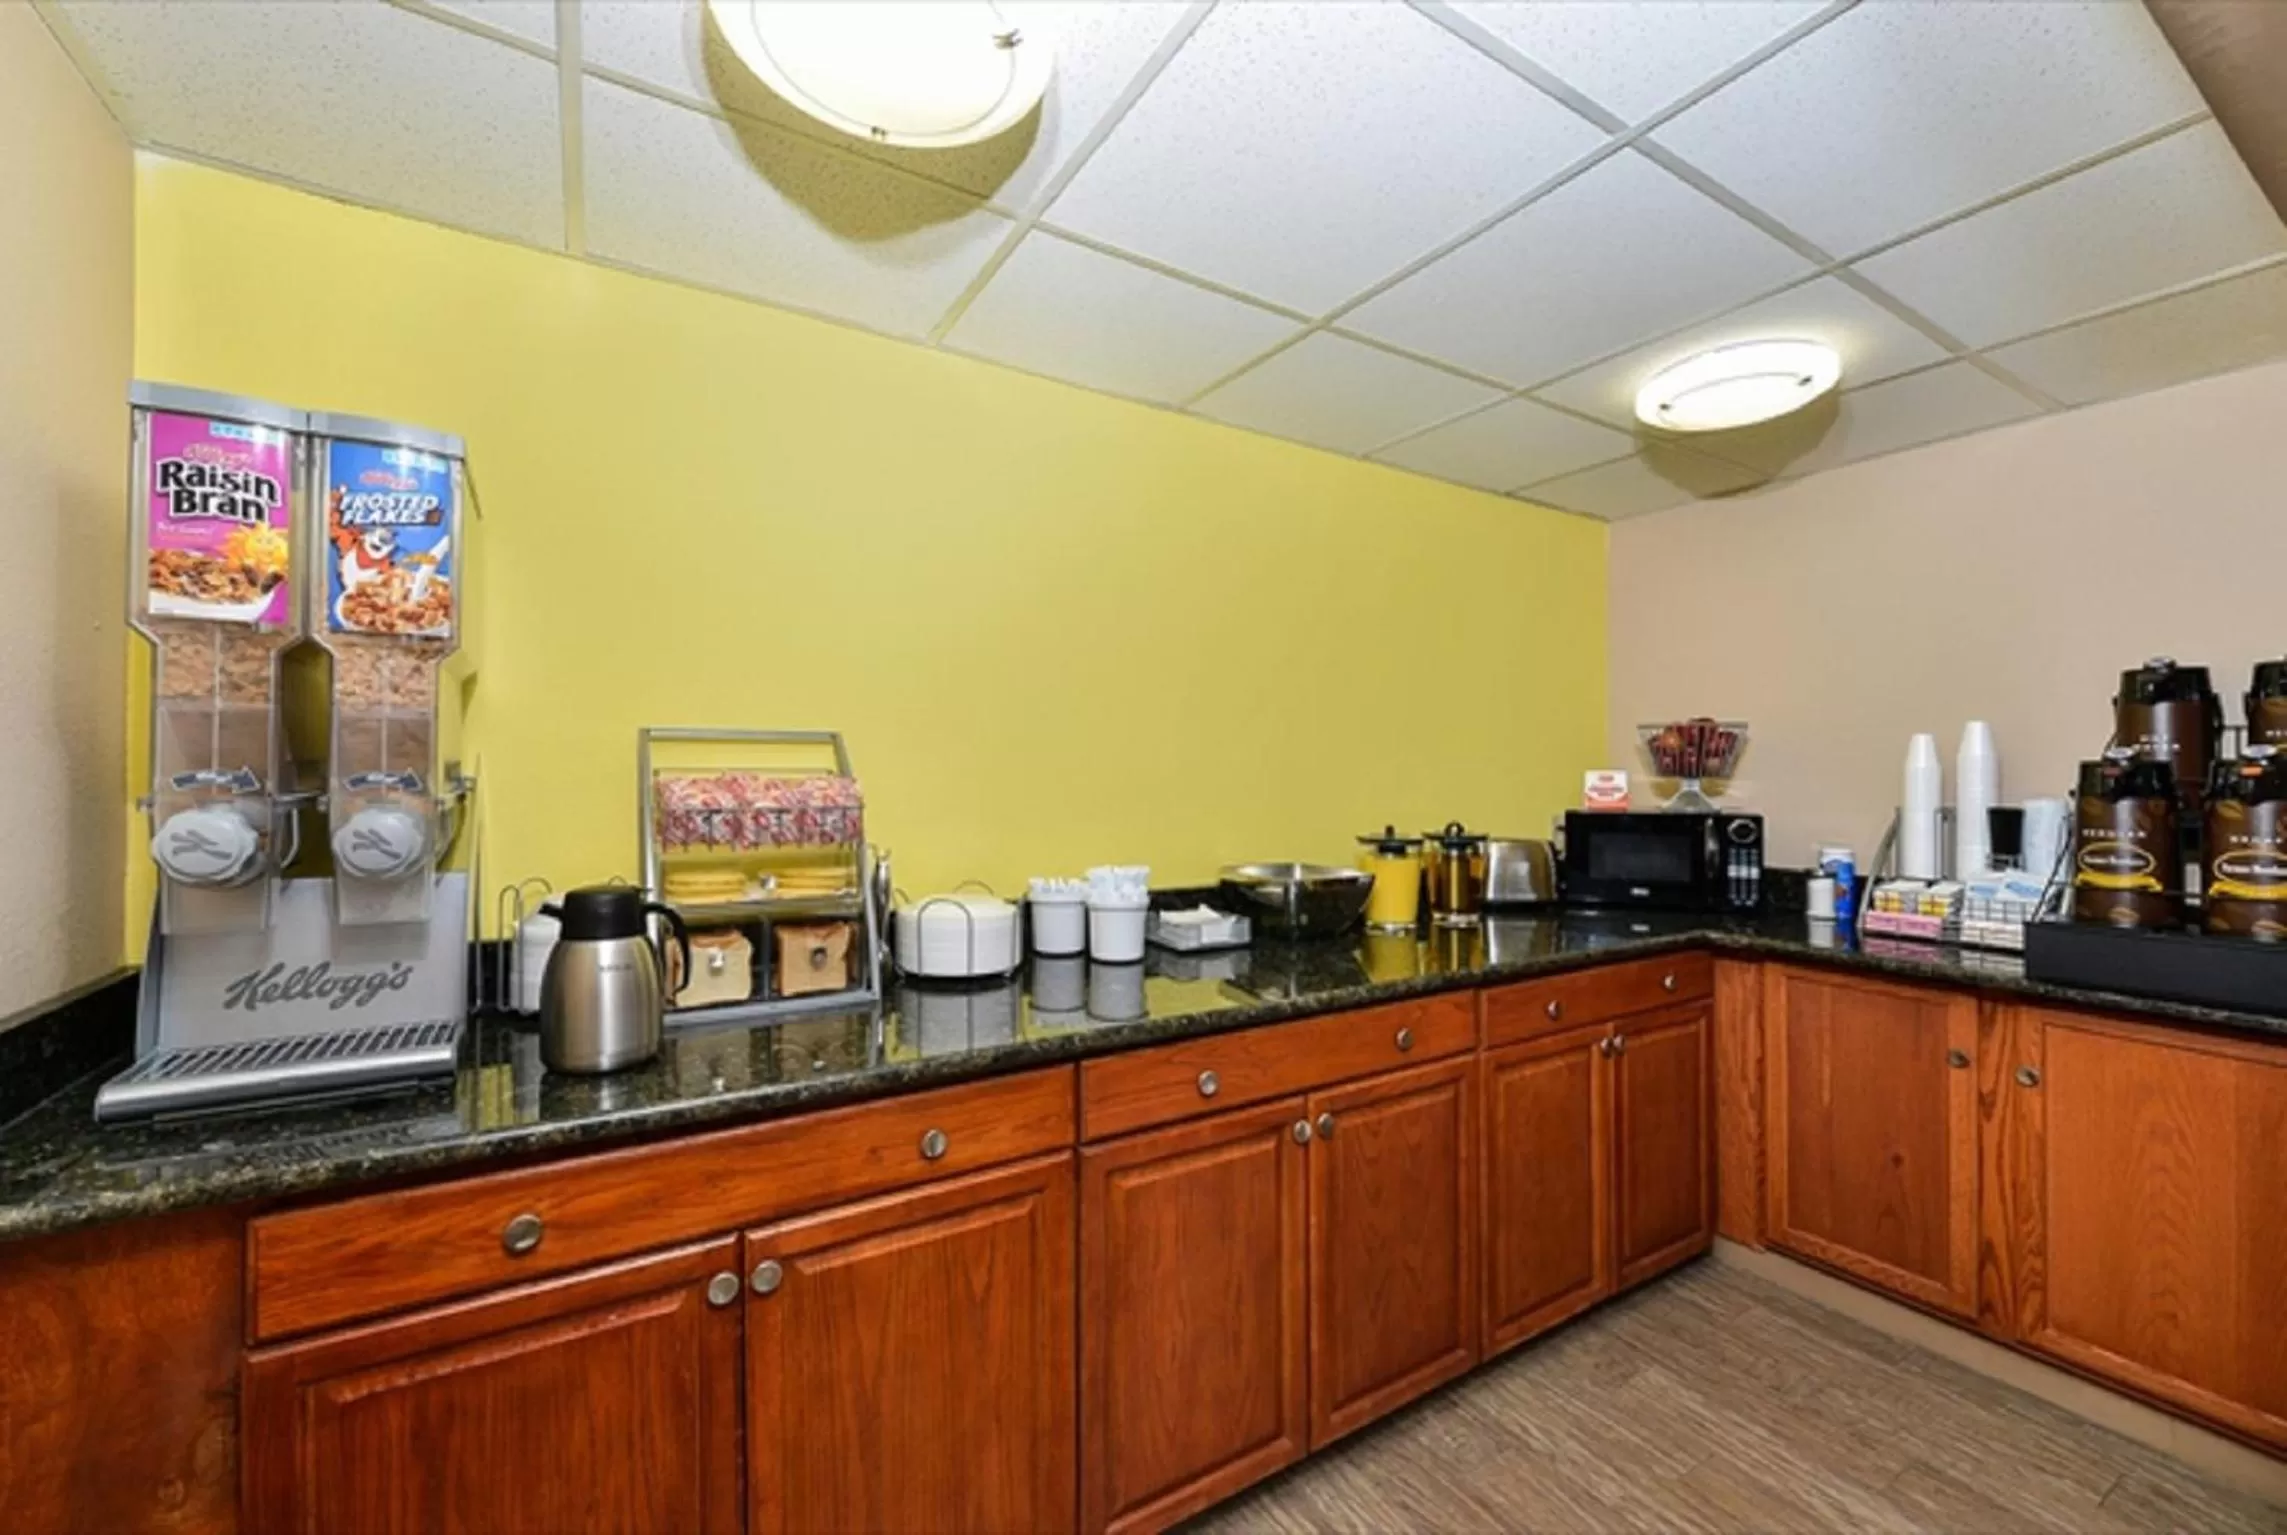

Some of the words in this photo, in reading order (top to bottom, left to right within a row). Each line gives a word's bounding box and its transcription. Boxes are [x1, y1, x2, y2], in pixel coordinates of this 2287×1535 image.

[158, 459, 279, 504] Raisin
[171, 489, 267, 521] Bran
[340, 494, 439, 511] FROSTED
[342, 510, 425, 525] FLAKES
[223, 961, 414, 1011] Kellogg's
